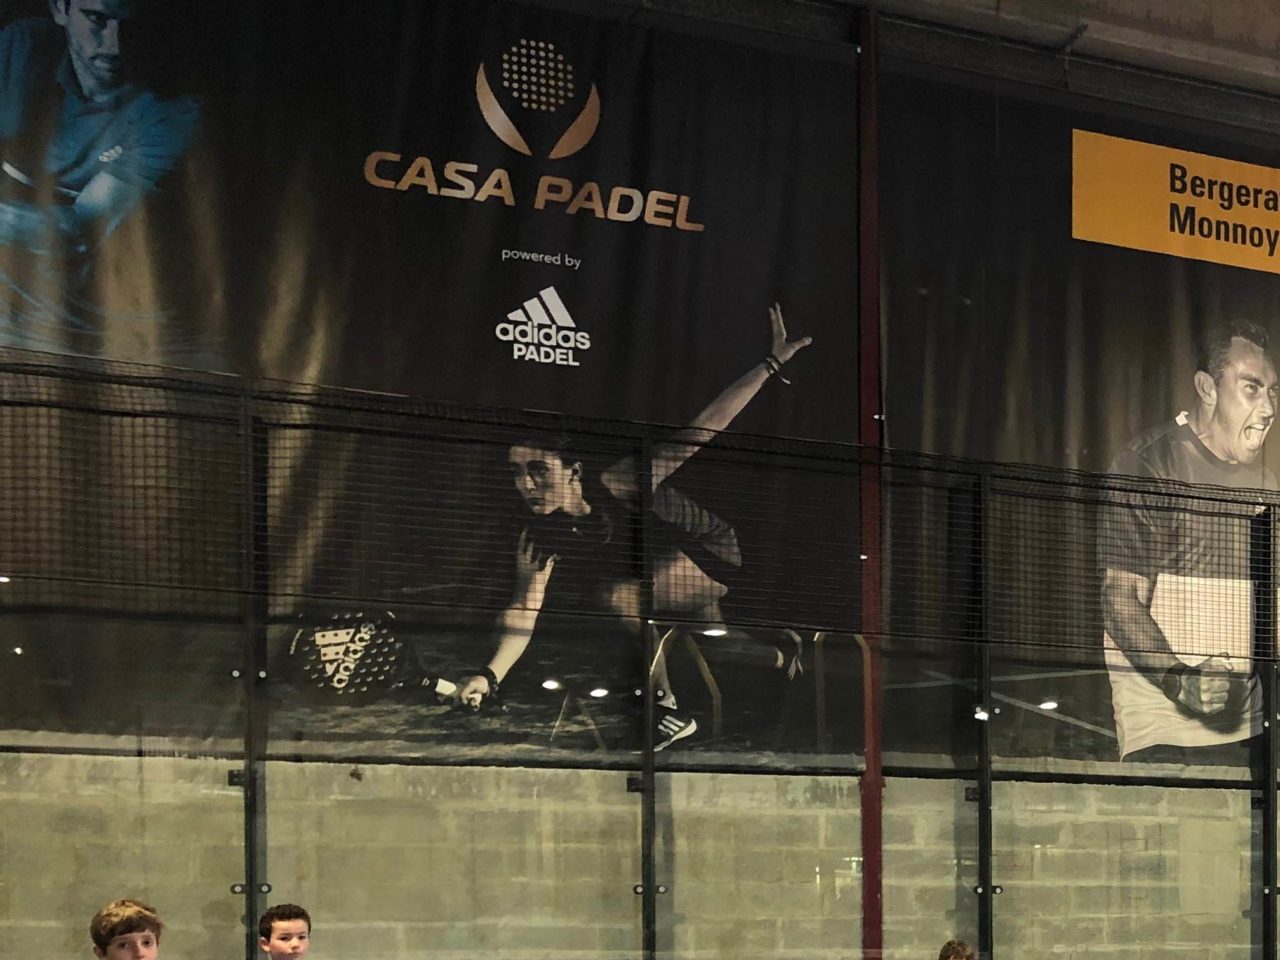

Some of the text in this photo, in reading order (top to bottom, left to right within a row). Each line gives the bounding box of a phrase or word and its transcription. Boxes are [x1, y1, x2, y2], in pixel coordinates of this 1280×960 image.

[364, 151, 704, 232] CASA PADEL
[501, 247, 581, 270] powered by
[495, 320, 591, 351] adidas
[513, 343, 580, 367] PADEL
